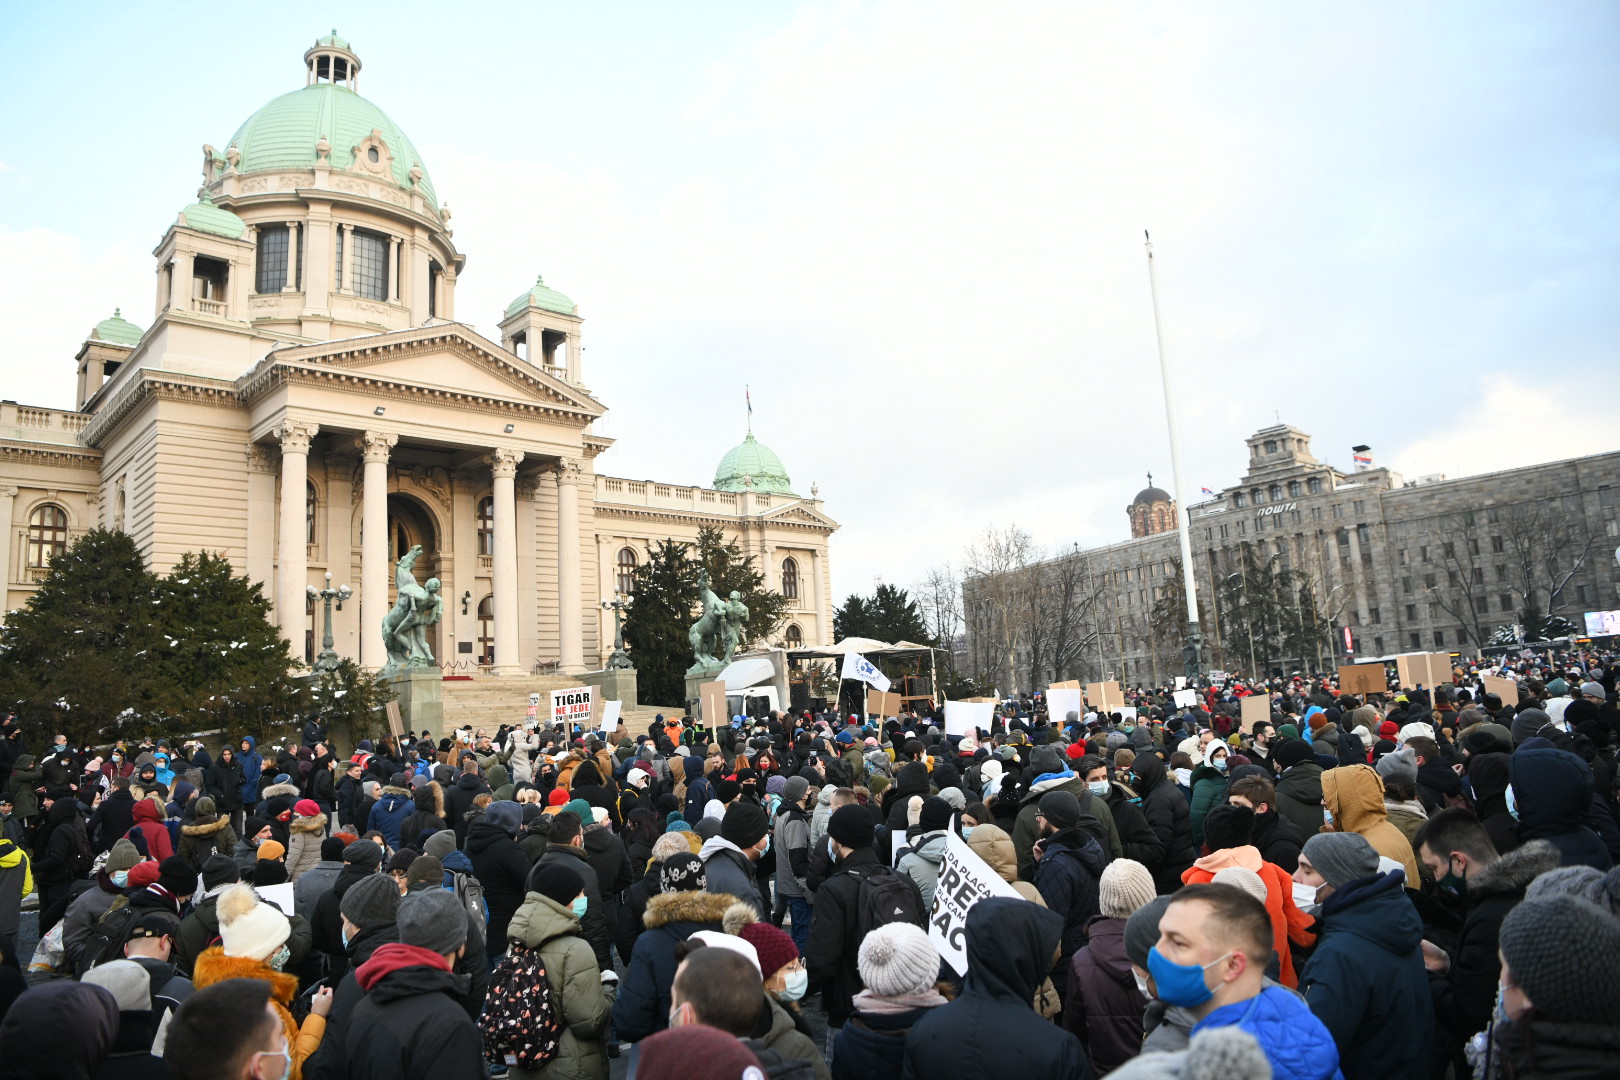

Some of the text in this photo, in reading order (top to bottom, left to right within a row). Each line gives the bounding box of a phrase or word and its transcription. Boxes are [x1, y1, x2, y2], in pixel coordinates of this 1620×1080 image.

[1257, 502, 1296, 516] ПОШТА
[555, 693, 590, 706] TIGAR
[556, 704, 590, 715] NE JEDE
[948, 853, 995, 897] DA PLAĆA
